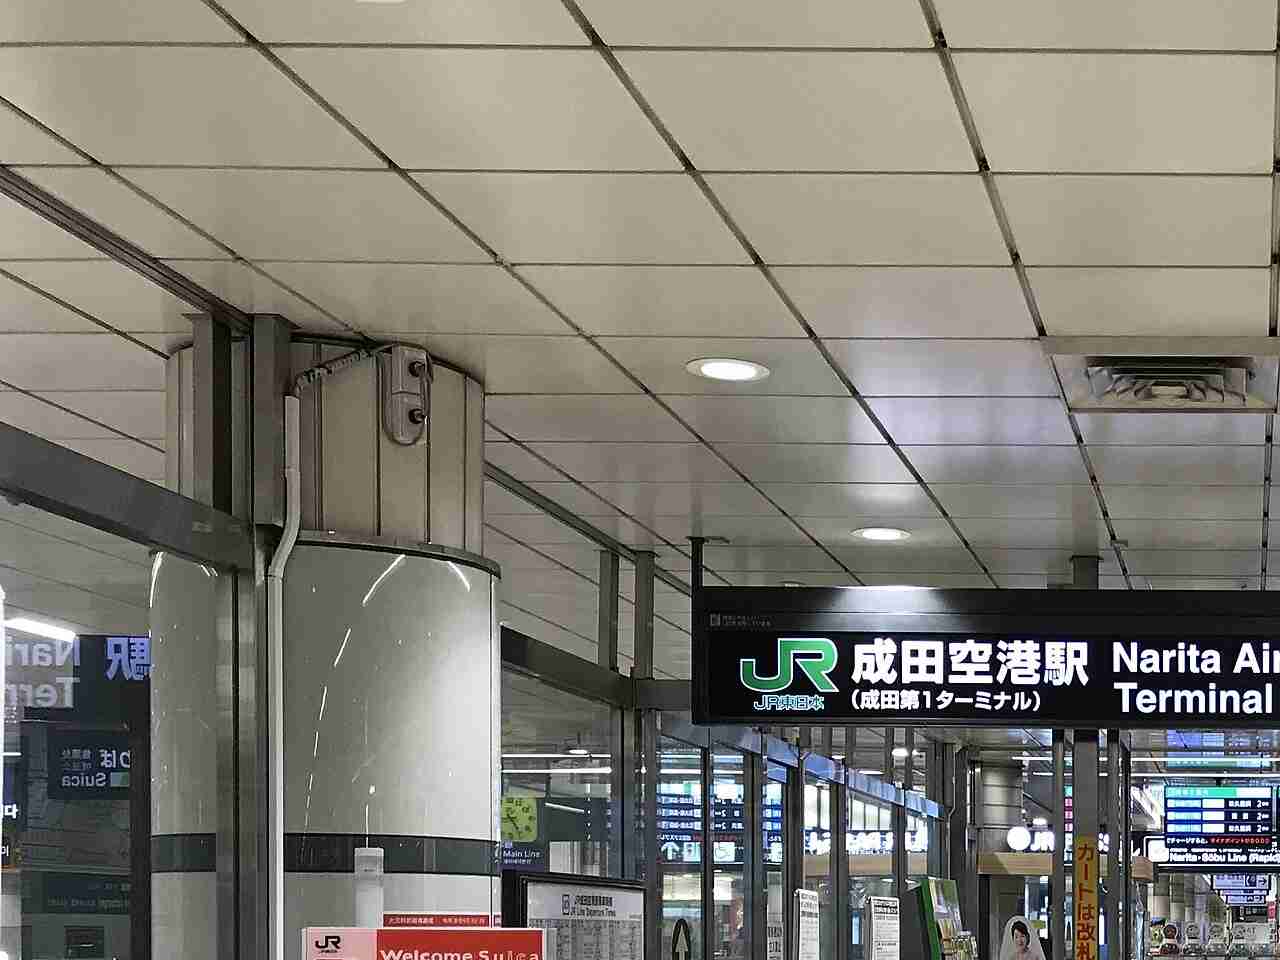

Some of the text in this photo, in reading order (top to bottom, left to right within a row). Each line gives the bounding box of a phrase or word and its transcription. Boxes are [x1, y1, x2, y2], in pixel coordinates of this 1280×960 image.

[740, 638, 839, 692] JR
[851, 639, 1089, 686] 成田空港駅
[1112, 642, 1222, 674] Narita
[1114, 682, 1275, 713] Terminal
[315, 936, 341, 949] JR
